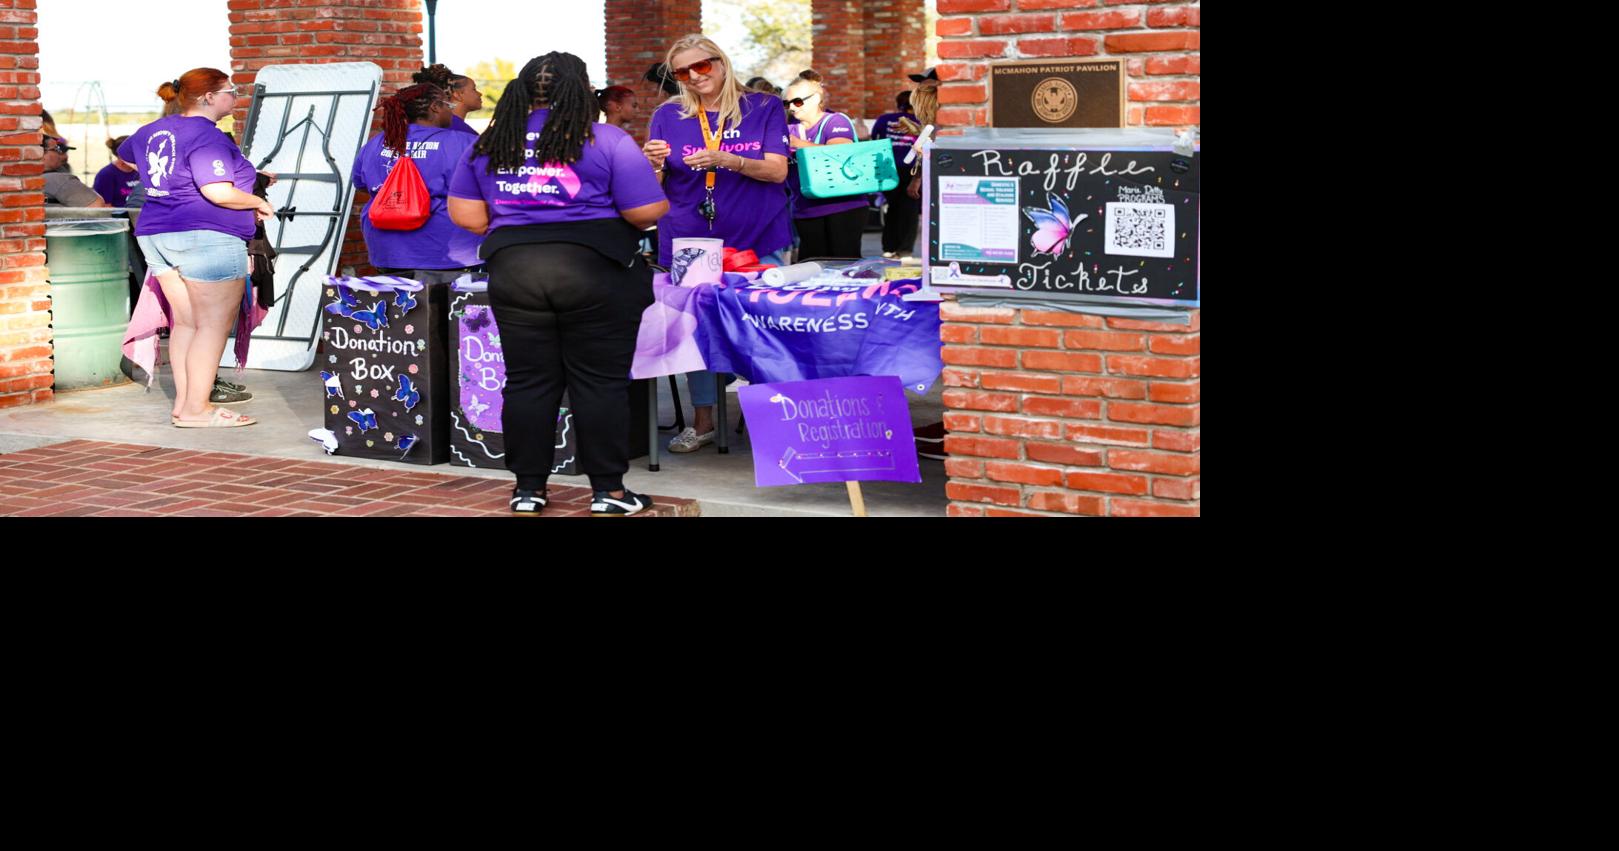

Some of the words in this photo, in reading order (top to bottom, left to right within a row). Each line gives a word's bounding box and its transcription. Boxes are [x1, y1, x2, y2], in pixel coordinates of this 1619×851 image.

[994, 66, 1038, 75] MCMAHON
[1040, 65, 1075, 73] PATRIOT
[1076, 63, 1117, 72] PAVILION
[682, 140, 761, 156] Suivors
[709, 128, 741, 141] Wth
[971, 149, 1155, 191] Raffle
[495, 180, 560, 195] Together.
[1016, 261, 1148, 294] Tickets
[330, 326, 419, 357] Donation
[349, 357, 395, 382] Box
[780, 389, 870, 421] Donations
[798, 418, 888, 448] Registration
